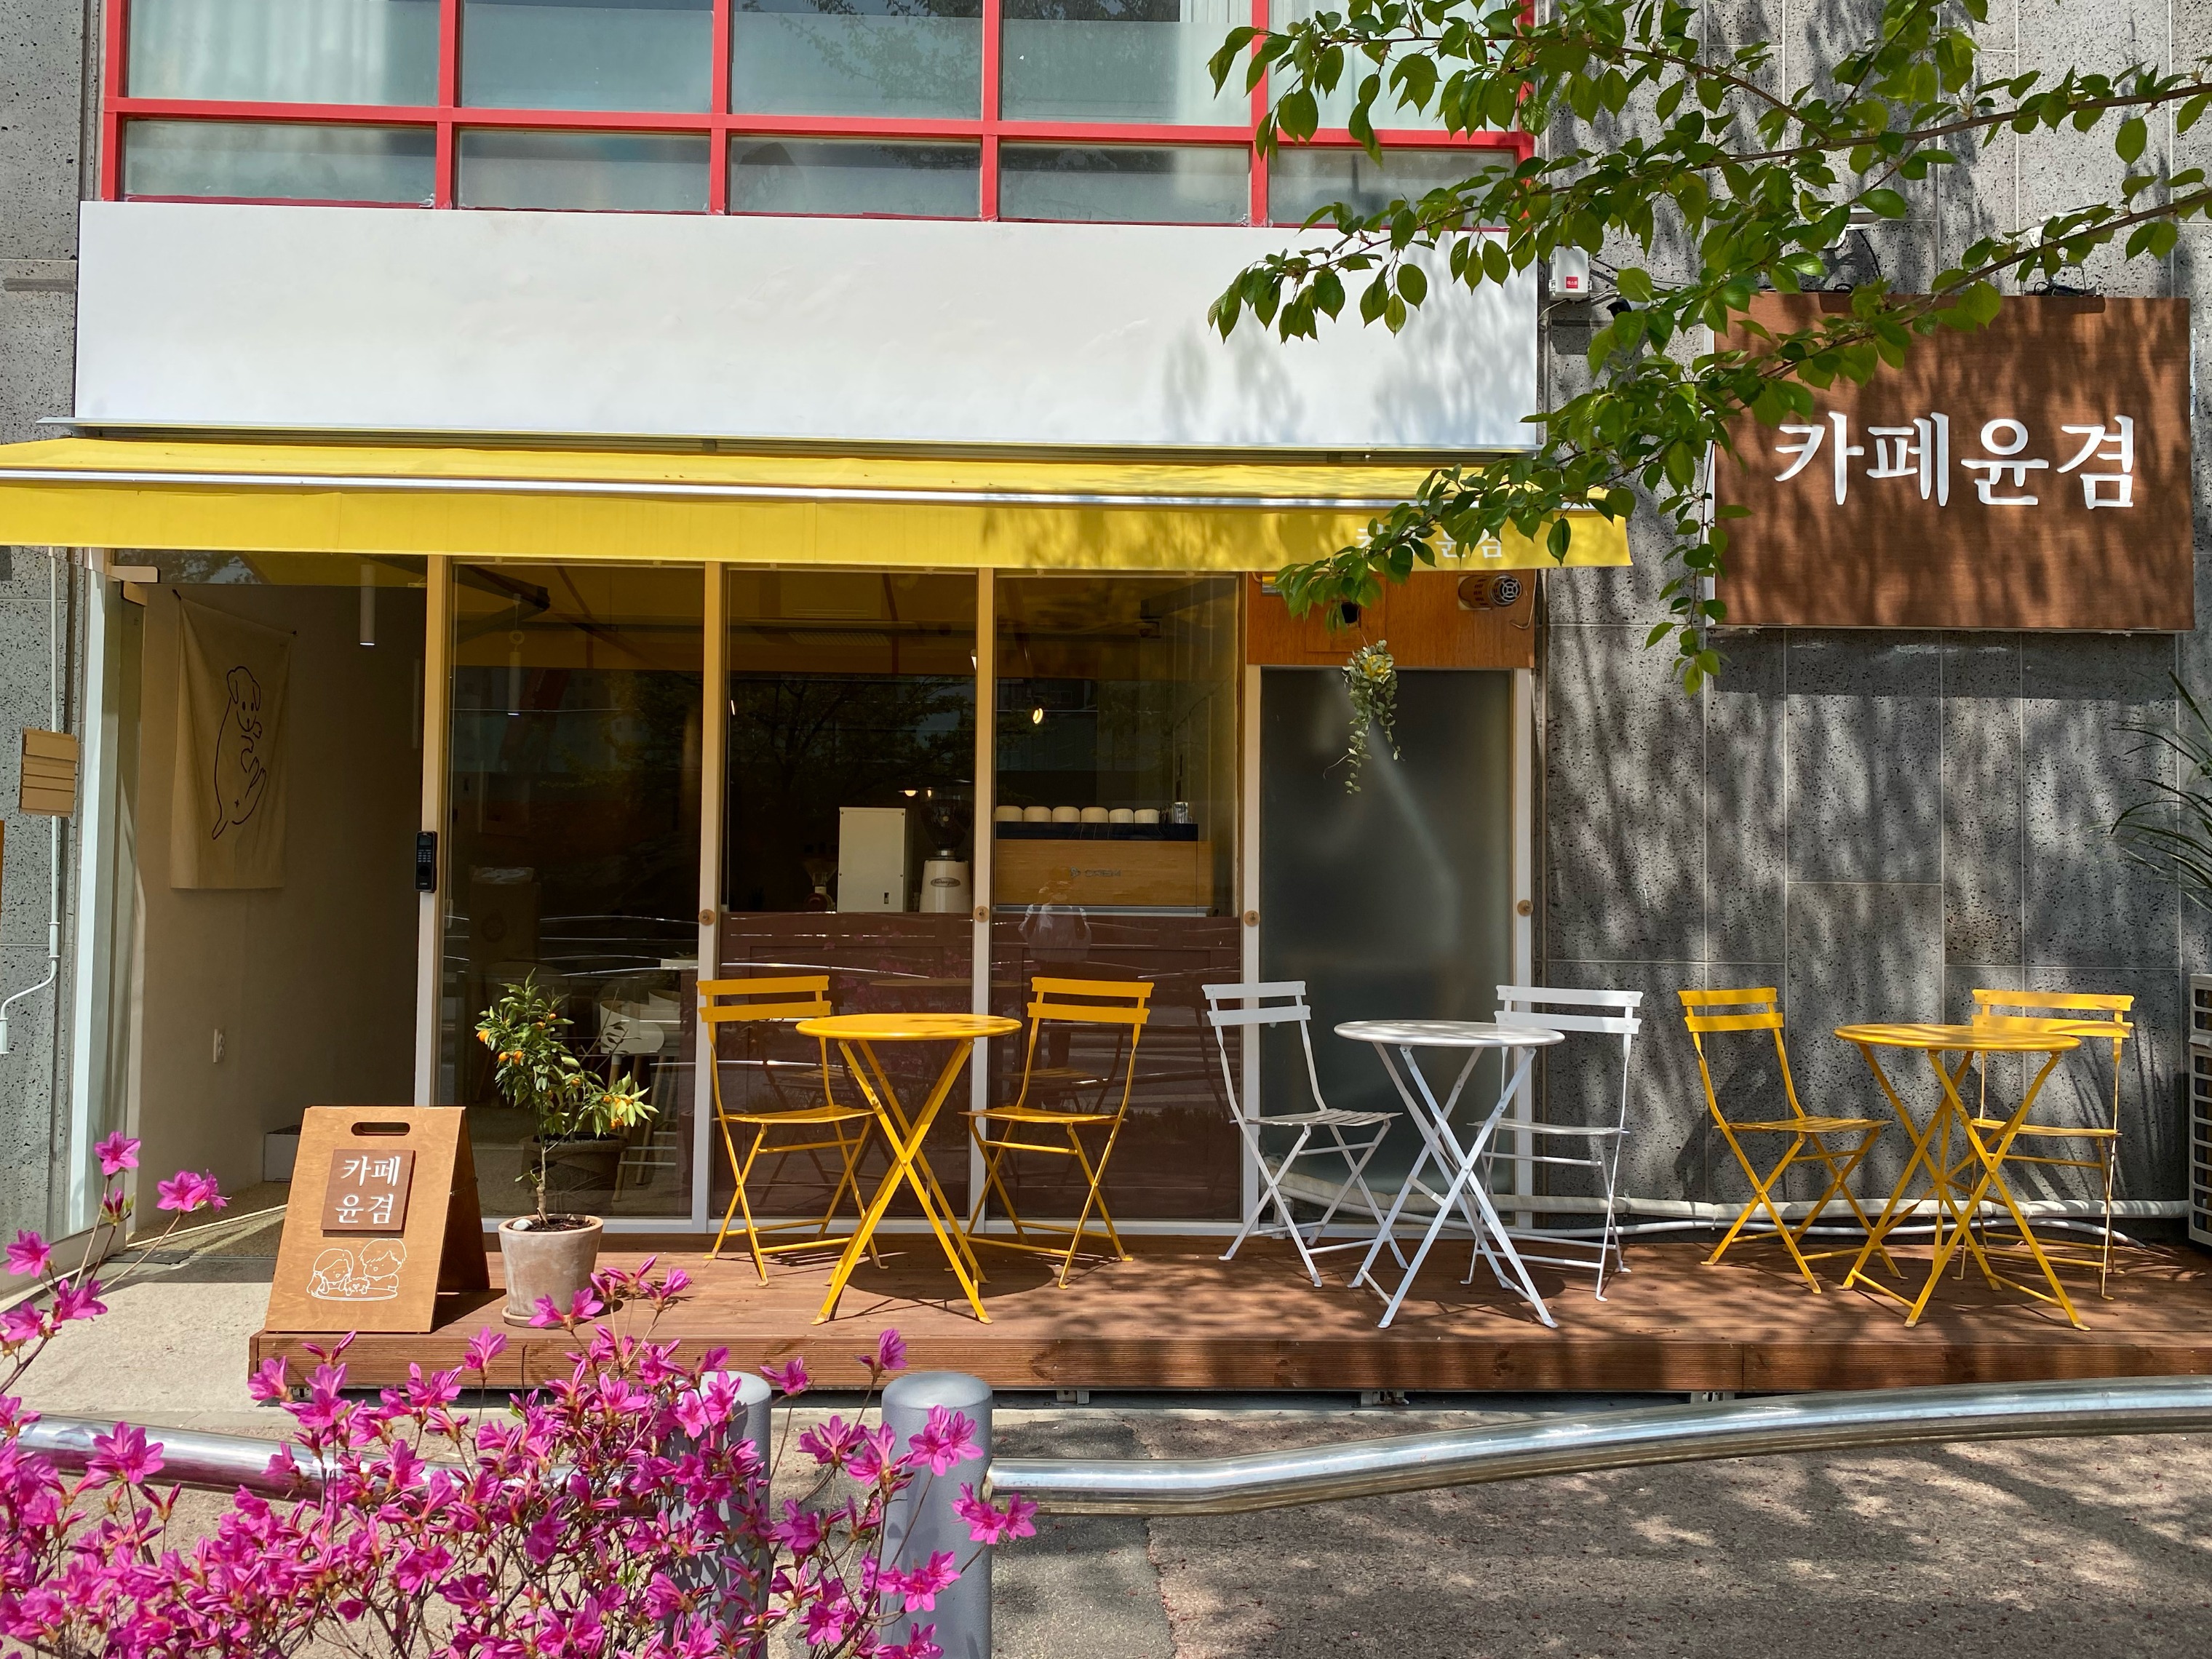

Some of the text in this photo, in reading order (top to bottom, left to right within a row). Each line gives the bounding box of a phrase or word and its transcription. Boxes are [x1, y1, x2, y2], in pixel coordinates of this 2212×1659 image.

[1775, 411, 2134, 509] 카페윤겸
[341, 1155, 401, 1187] 카페
[335, 1194, 394, 1225] 윤겸
